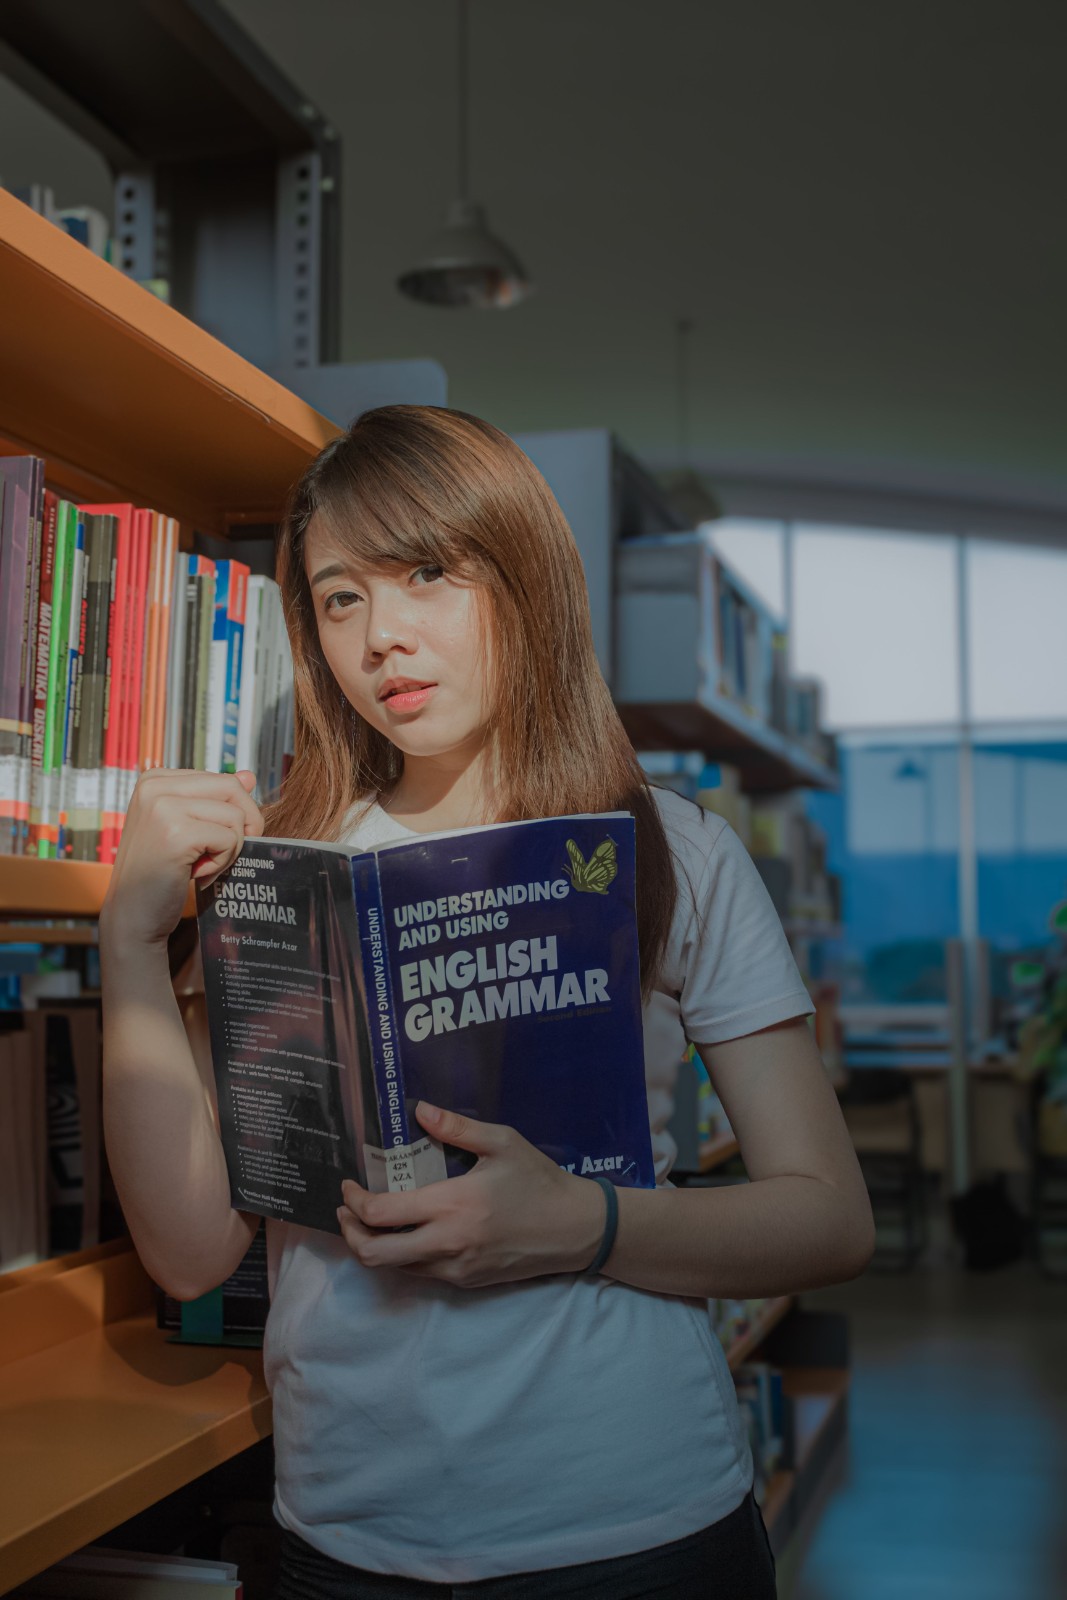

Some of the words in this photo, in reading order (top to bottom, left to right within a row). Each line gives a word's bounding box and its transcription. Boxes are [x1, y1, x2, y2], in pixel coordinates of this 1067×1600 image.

[35, 602, 53, 701] MATEMATIKA
[231, 867, 256, 879] USING
[234, 857, 275, 870] STANDING
[214, 882, 277, 903] ENGLISH
[393, 879, 570, 928] UNDERSTANDING
[214, 899, 297, 926] GRAMMAR
[398, 923, 441, 952] AND
[445, 911, 509, 940] USING
[220, 934, 240, 946] Betty
[241, 936, 280, 949] Schrampfer
[281, 941, 298, 951] Azar
[367, 907, 389, 1012] UNDERSTANDING
[400, 935, 559, 1002] ENGLISH
[404, 968, 612, 1042] GRAMMAR
[378, 1012, 392, 1040] AND
[382, 1041, 396, 1079] USING
[386, 1081, 402, 1133] ENGLISH
[580, 1155, 624, 1175] Azar
